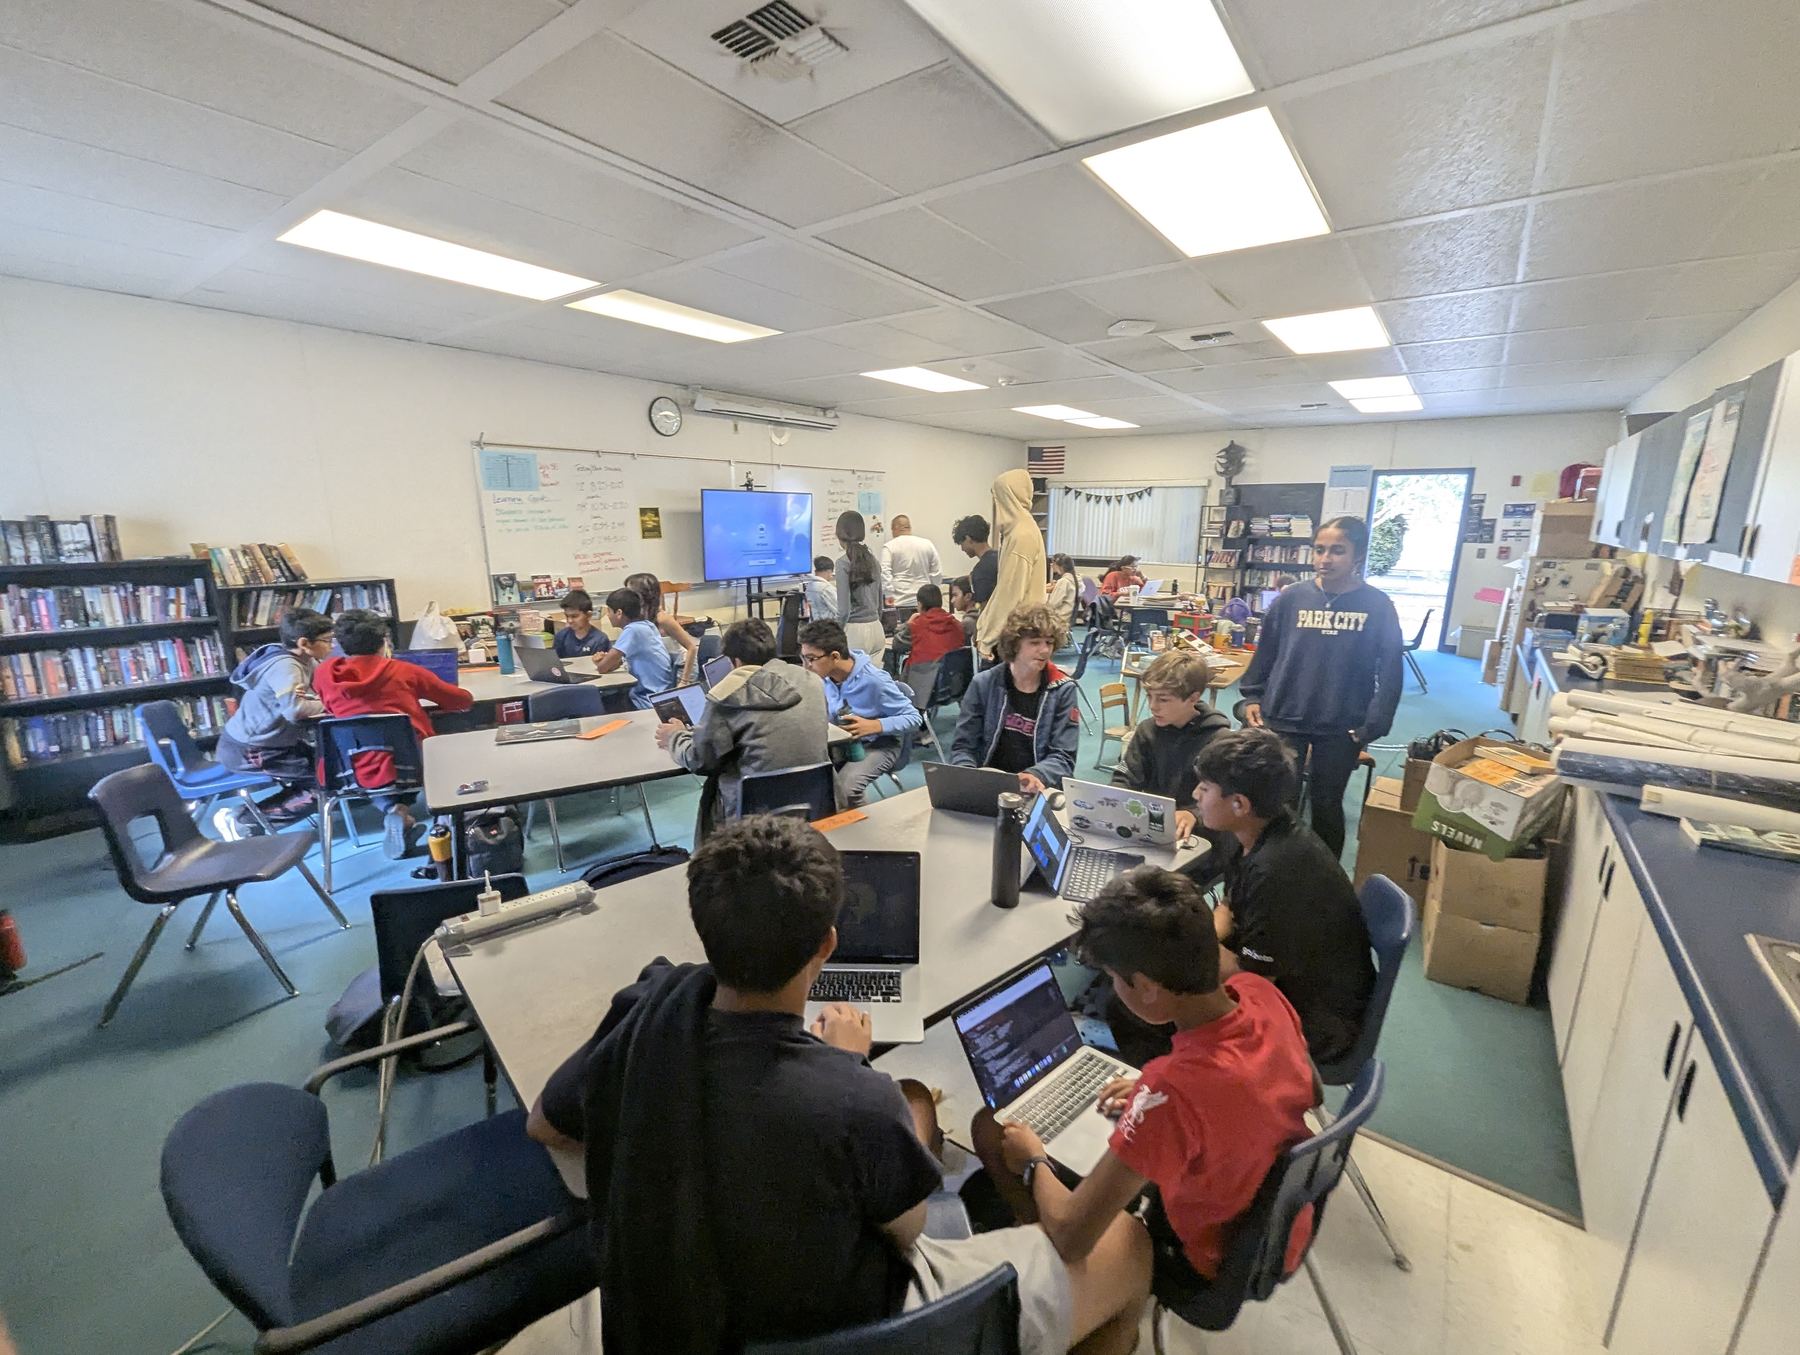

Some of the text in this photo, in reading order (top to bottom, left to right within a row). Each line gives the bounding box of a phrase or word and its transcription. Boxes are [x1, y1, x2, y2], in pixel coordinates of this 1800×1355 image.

[1296, 610, 1368, 631] PARK CITY
[1431, 820, 1483, 850] NAVELS
